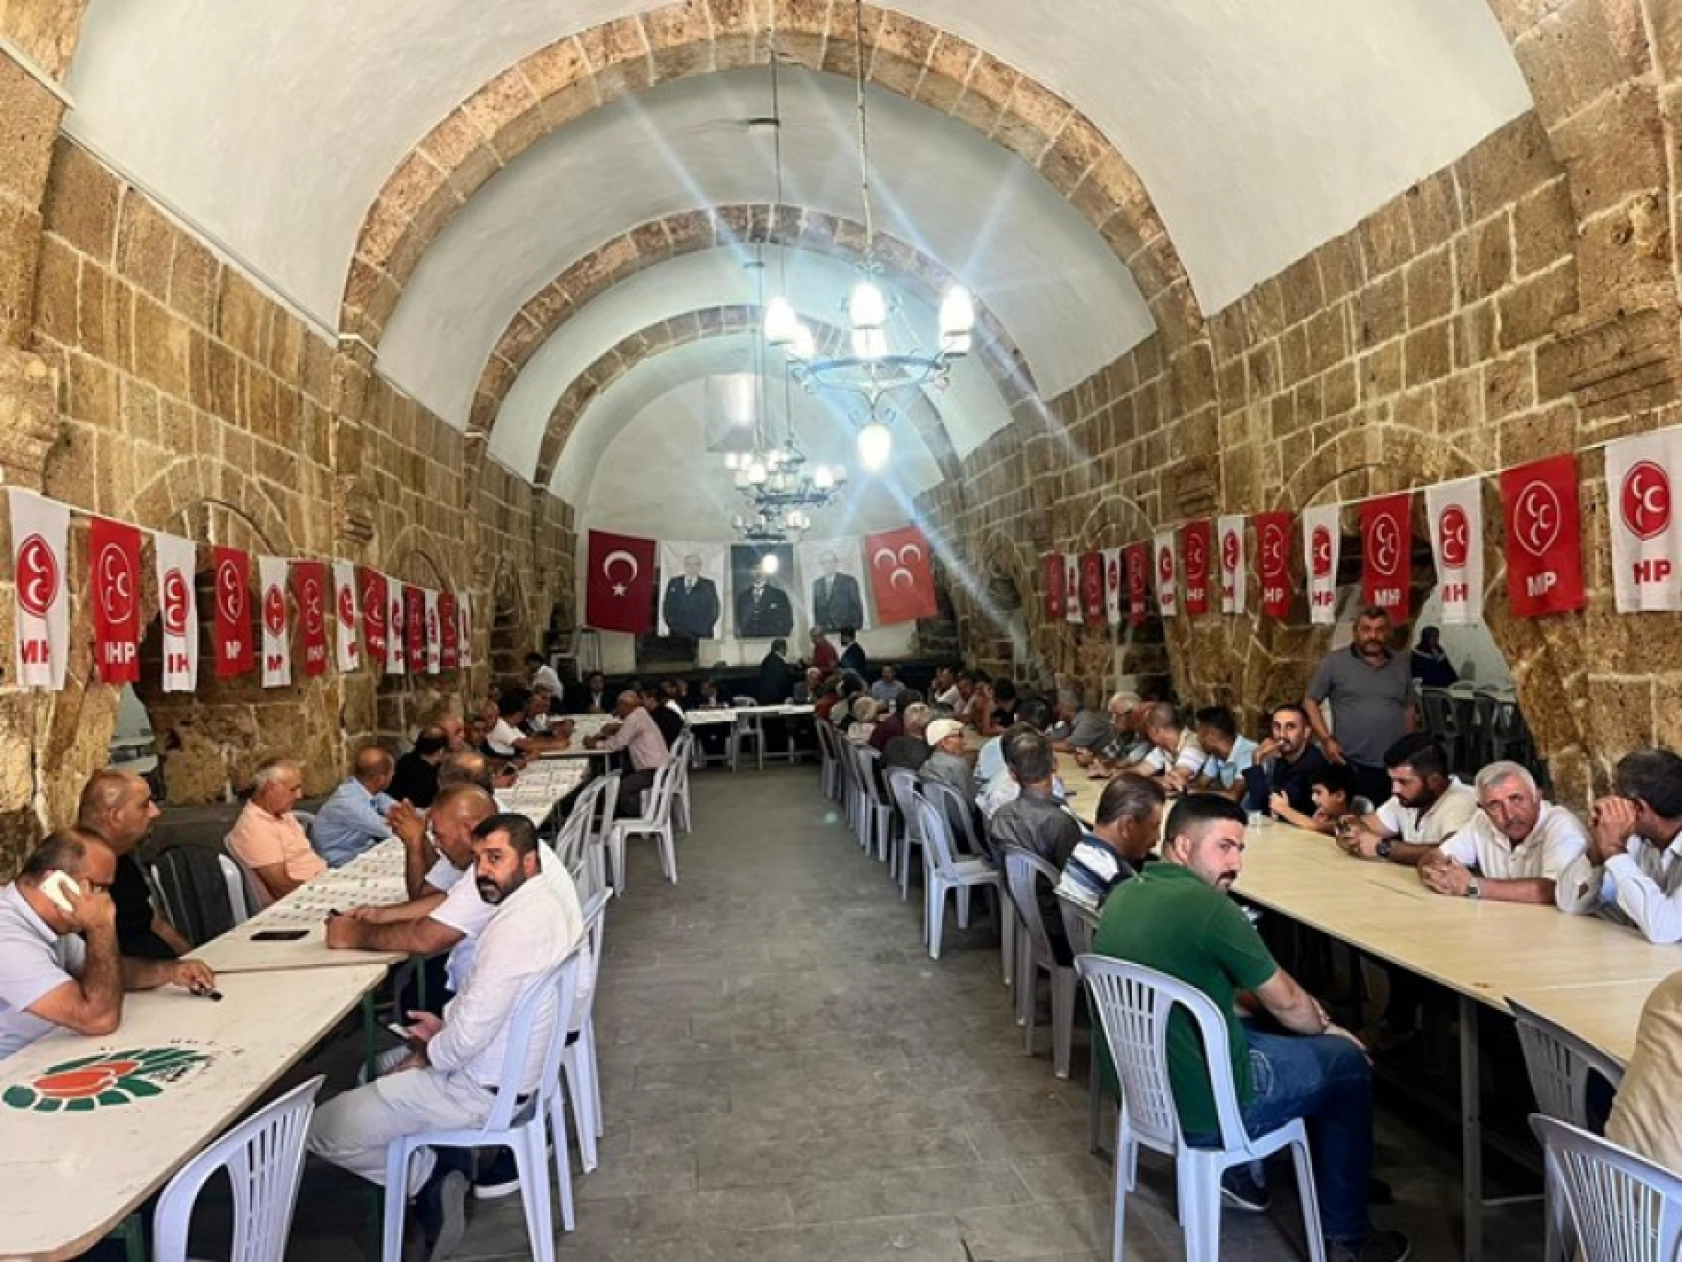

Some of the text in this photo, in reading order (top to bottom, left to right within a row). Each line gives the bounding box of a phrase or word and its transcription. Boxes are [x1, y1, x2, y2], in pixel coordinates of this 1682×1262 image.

[1633, 559, 1671, 586] HP
[1263, 588, 1284, 603] HP
[1312, 590, 1334, 606] HP
[104, 641, 136, 665] HP
